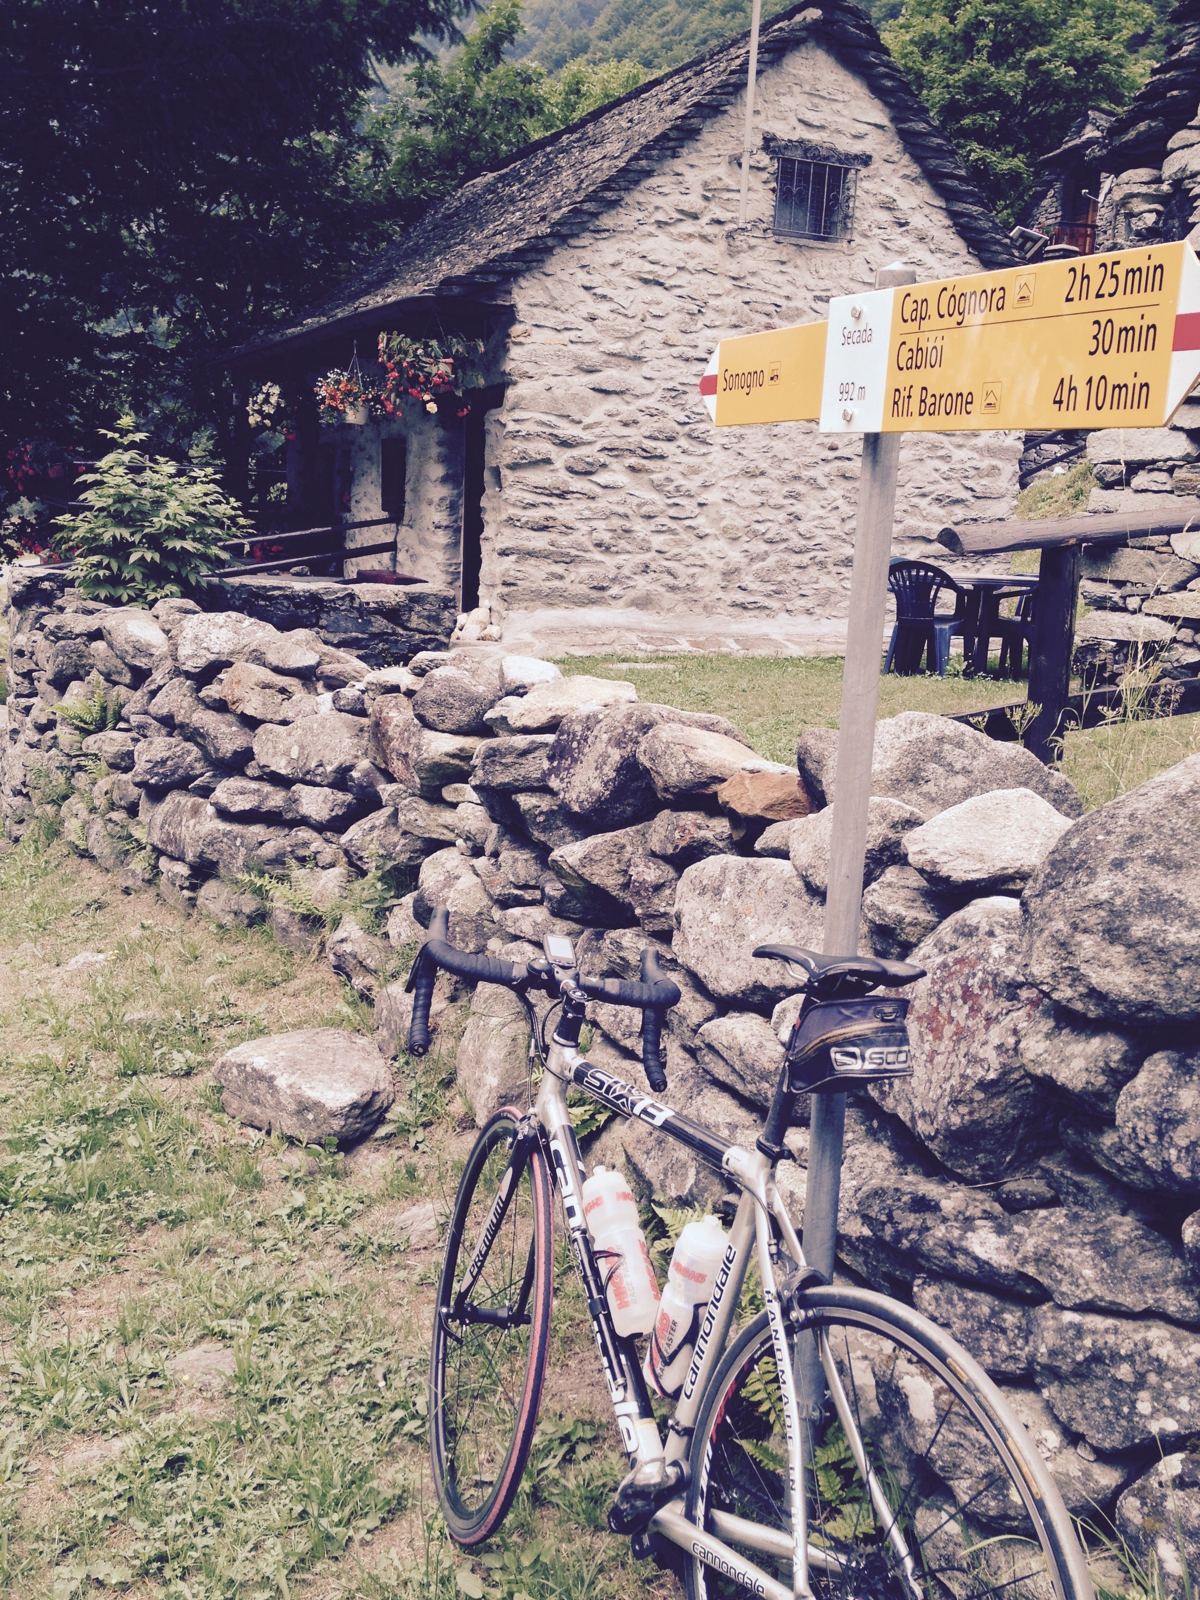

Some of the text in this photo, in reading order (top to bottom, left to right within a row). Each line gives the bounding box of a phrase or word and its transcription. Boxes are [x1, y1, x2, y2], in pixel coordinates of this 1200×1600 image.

[901, 292, 931, 330] Cap.
[937, 284, 1006, 326] Cógnora
[841, 322, 873, 346] Secada
[896, 335, 945, 372] Cabiói
[722, 368, 765, 396] Sonogno
[838, 381, 866, 402] 992 m
[891, 384, 914, 418] Rif.
[918, 386, 974, 417] Barone
[684, 1245, 737, 1400] cannondale
[691, 1541, 766, 1597] cannondale
